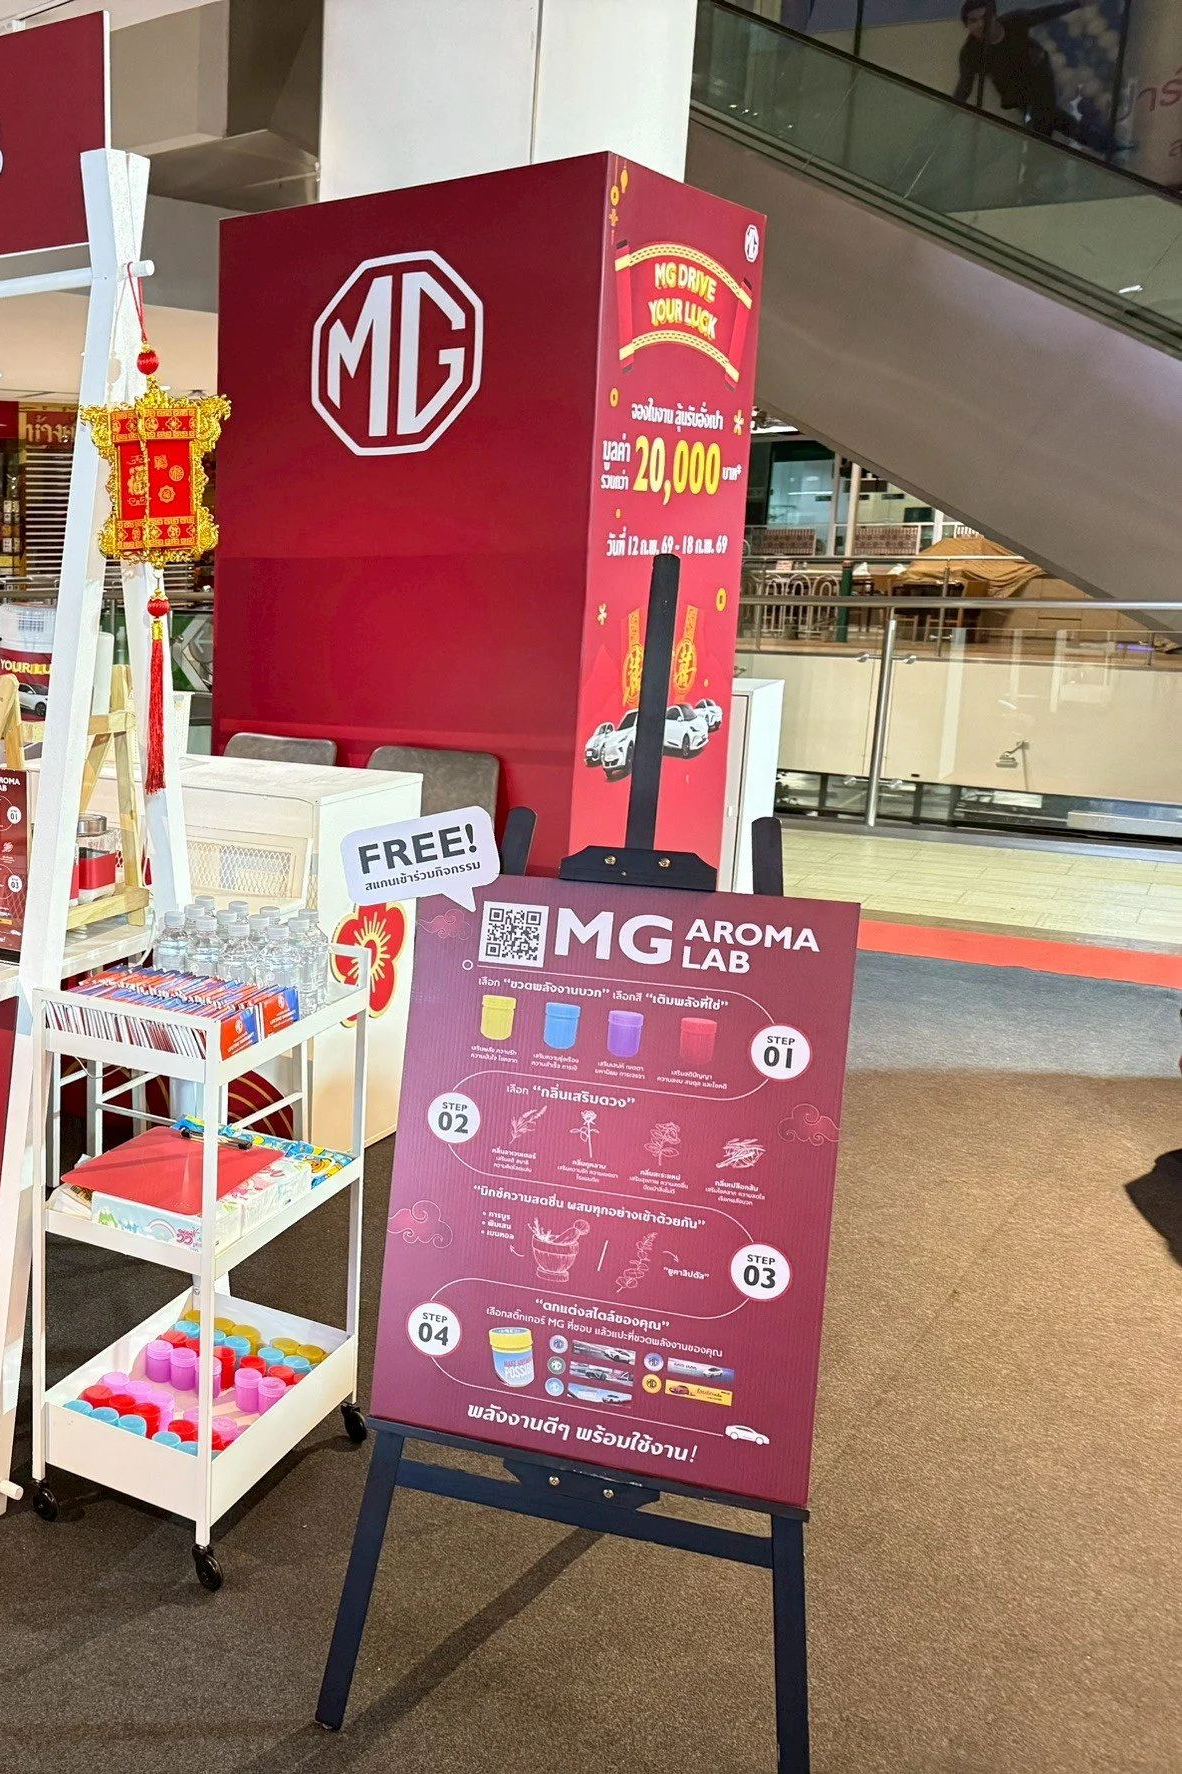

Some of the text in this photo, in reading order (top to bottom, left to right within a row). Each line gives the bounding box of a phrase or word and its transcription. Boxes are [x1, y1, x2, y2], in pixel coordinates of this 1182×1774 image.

[654, 262, 717, 303] MG DRIVE
[648, 298, 718, 340] YOUR LUCK
[324, 267, 468, 440] MG
[602, 433, 631, 471] มูลค่า
[632, 435, 721, 506] 20,000
[606, 526, 627, 557] วันที่
[628, 535, 639, 556] 12
[661, 535, 674, 555] 69
[682, 535, 694, 555] 18
[715, 535, 729, 554] 69
[0, 659, 52, 676] YOUR LU
[357, 823, 478, 875] FREE!
[365, 860, 481, 891] สแกนเข้าร่วมกิจกรรม
[554, 907, 820, 965] MG AROMA
[681, 945, 751, 974] LAB
[478, 976, 501, 987] เลือก
[612, 990, 643, 1002] เลือกสี
[767, 1035, 795, 1046] STEP
[763, 1046, 793, 1069] 01
[506, 1083, 529, 1095] เลือก
[442, 1101, 468, 1111] STEP
[438, 1111, 469, 1134] 02
[747, 1253, 776, 1265] STEP
[743, 1265, 776, 1289] 03
[422, 1312, 448, 1323] STEP
[547, 1317, 565, 1329] MG
[567, 1320, 593, 1335] ที่ชอบ
[418, 1322, 449, 1346] 04
[467, 1403, 699, 1463] พลังงานดีๆ พร้อมใช้งาน!
